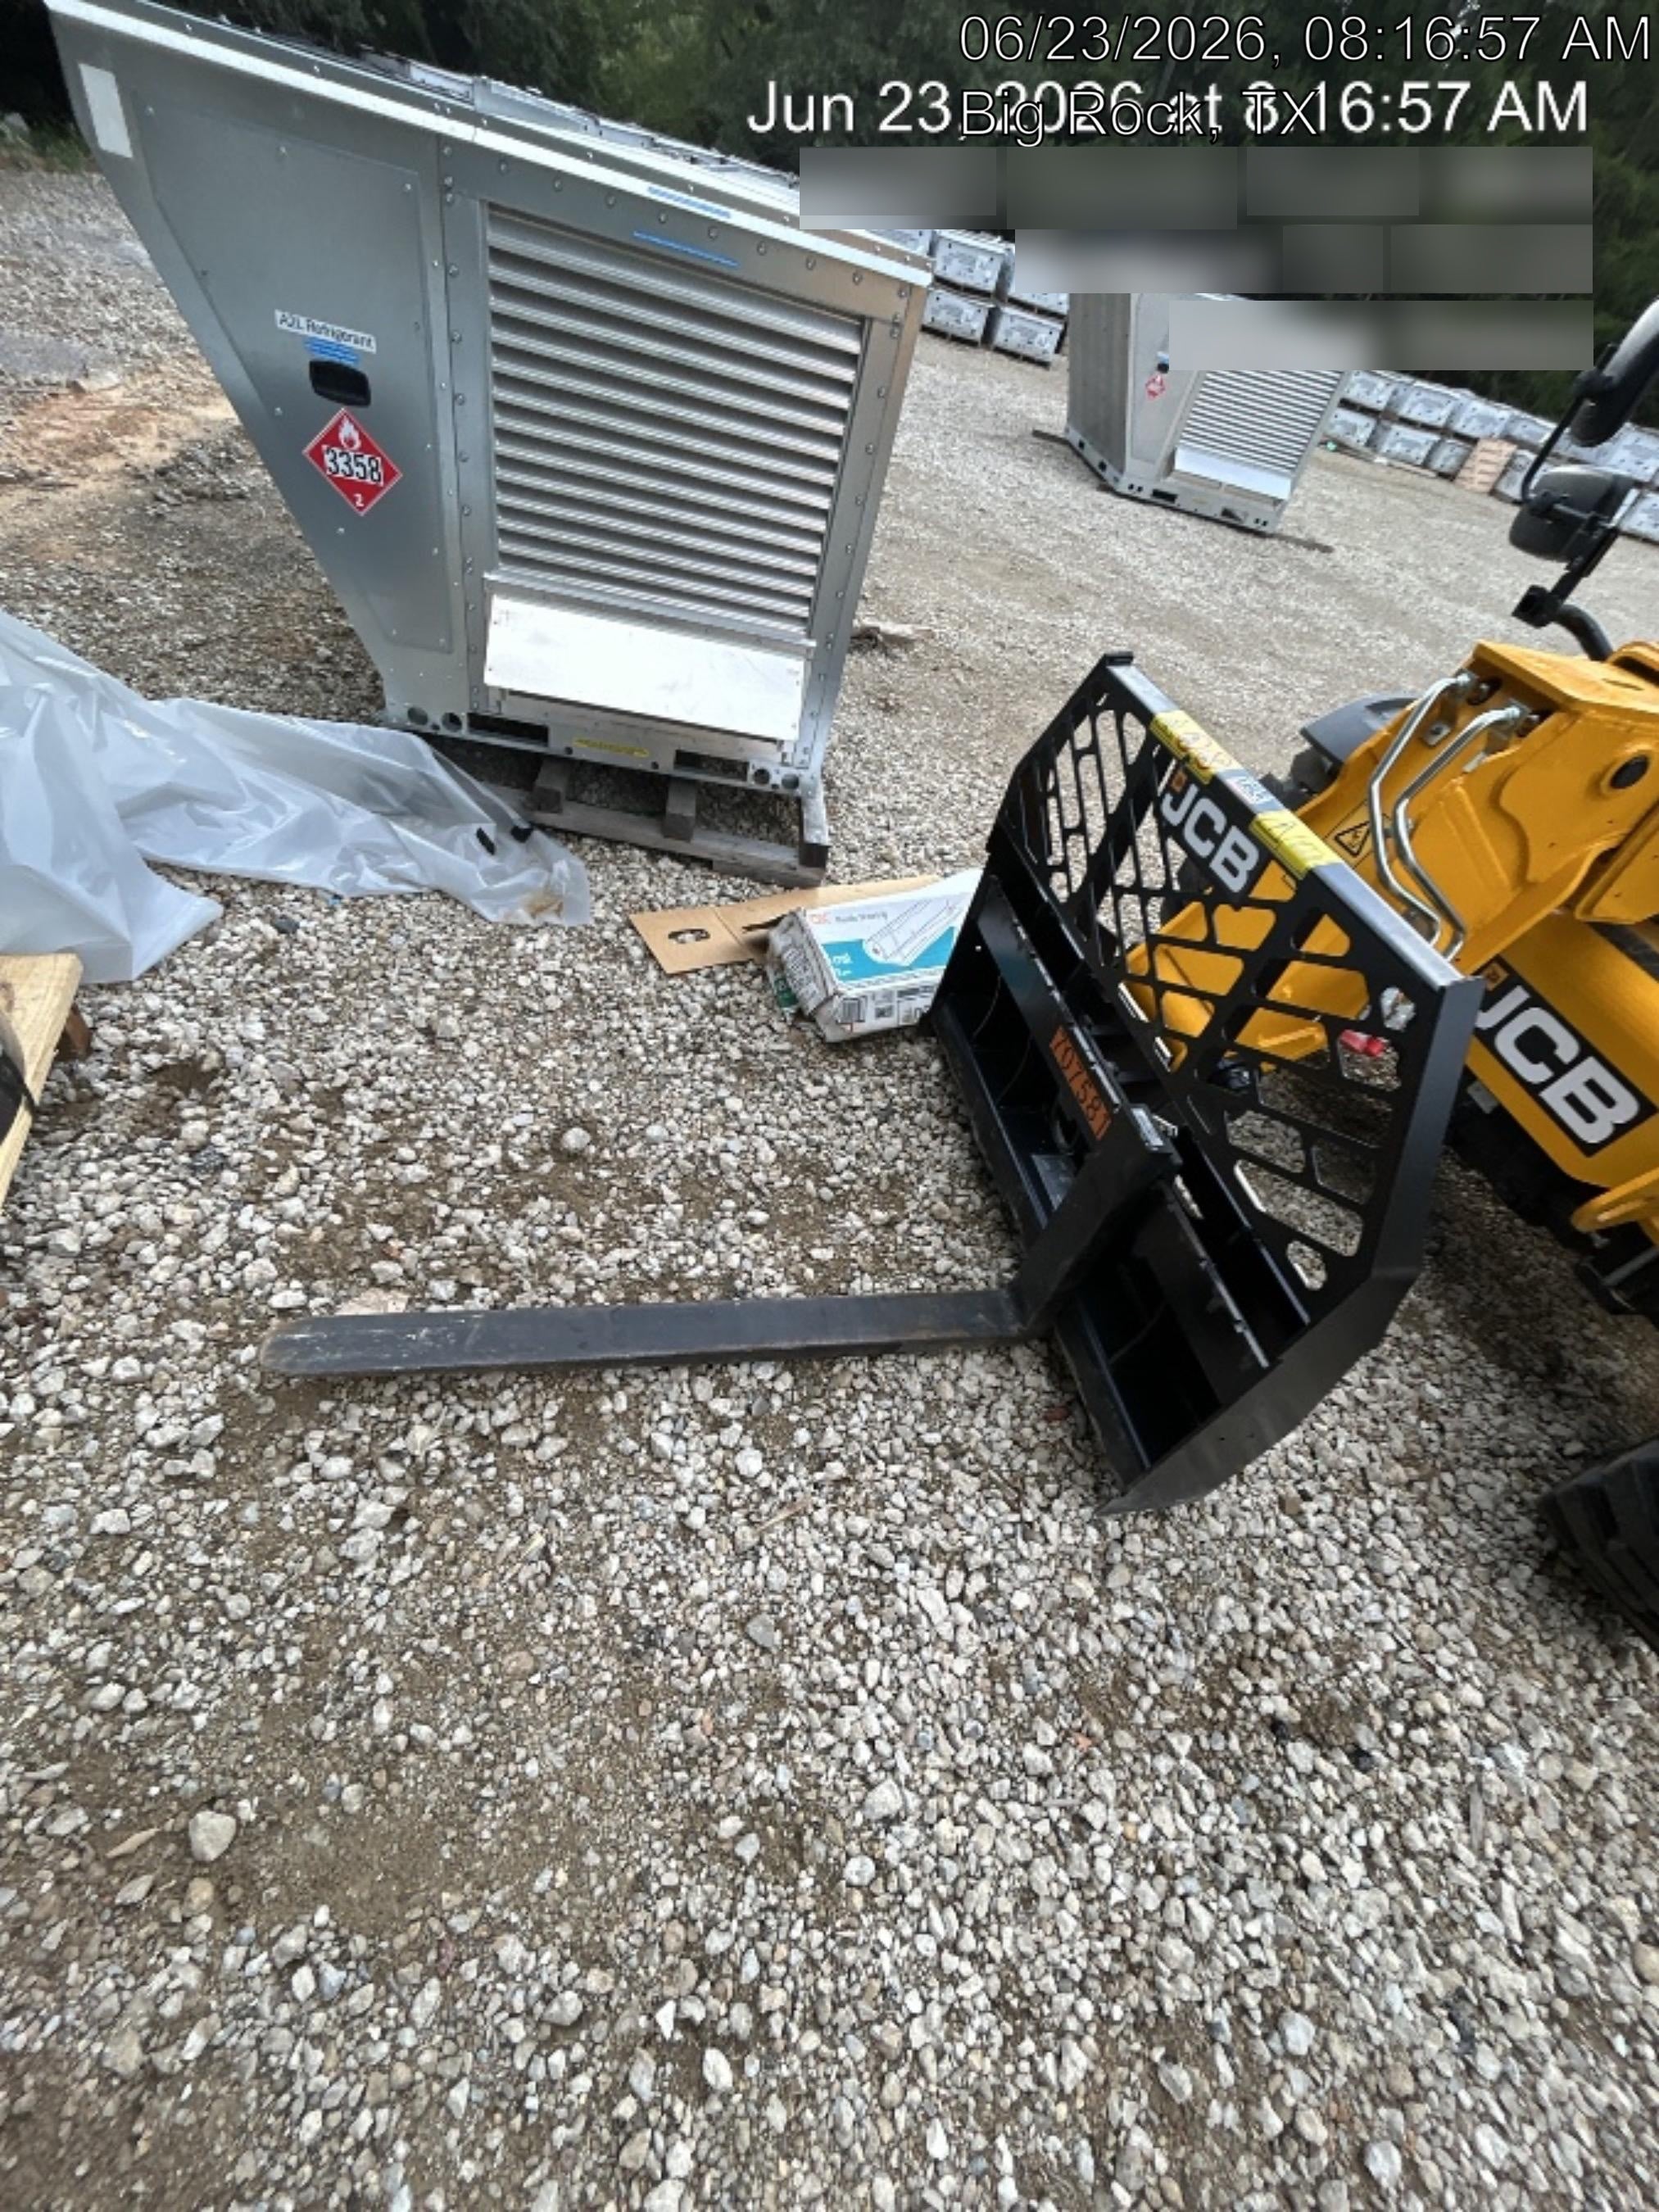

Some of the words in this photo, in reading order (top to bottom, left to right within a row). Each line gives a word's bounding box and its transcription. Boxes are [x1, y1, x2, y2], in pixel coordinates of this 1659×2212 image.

[325, 446, 382, 483] 3358
[353, 492, 365, 507] 2
[1160, 783, 1260, 894] JCB
[1475, 984, 1640, 1145] JCB
